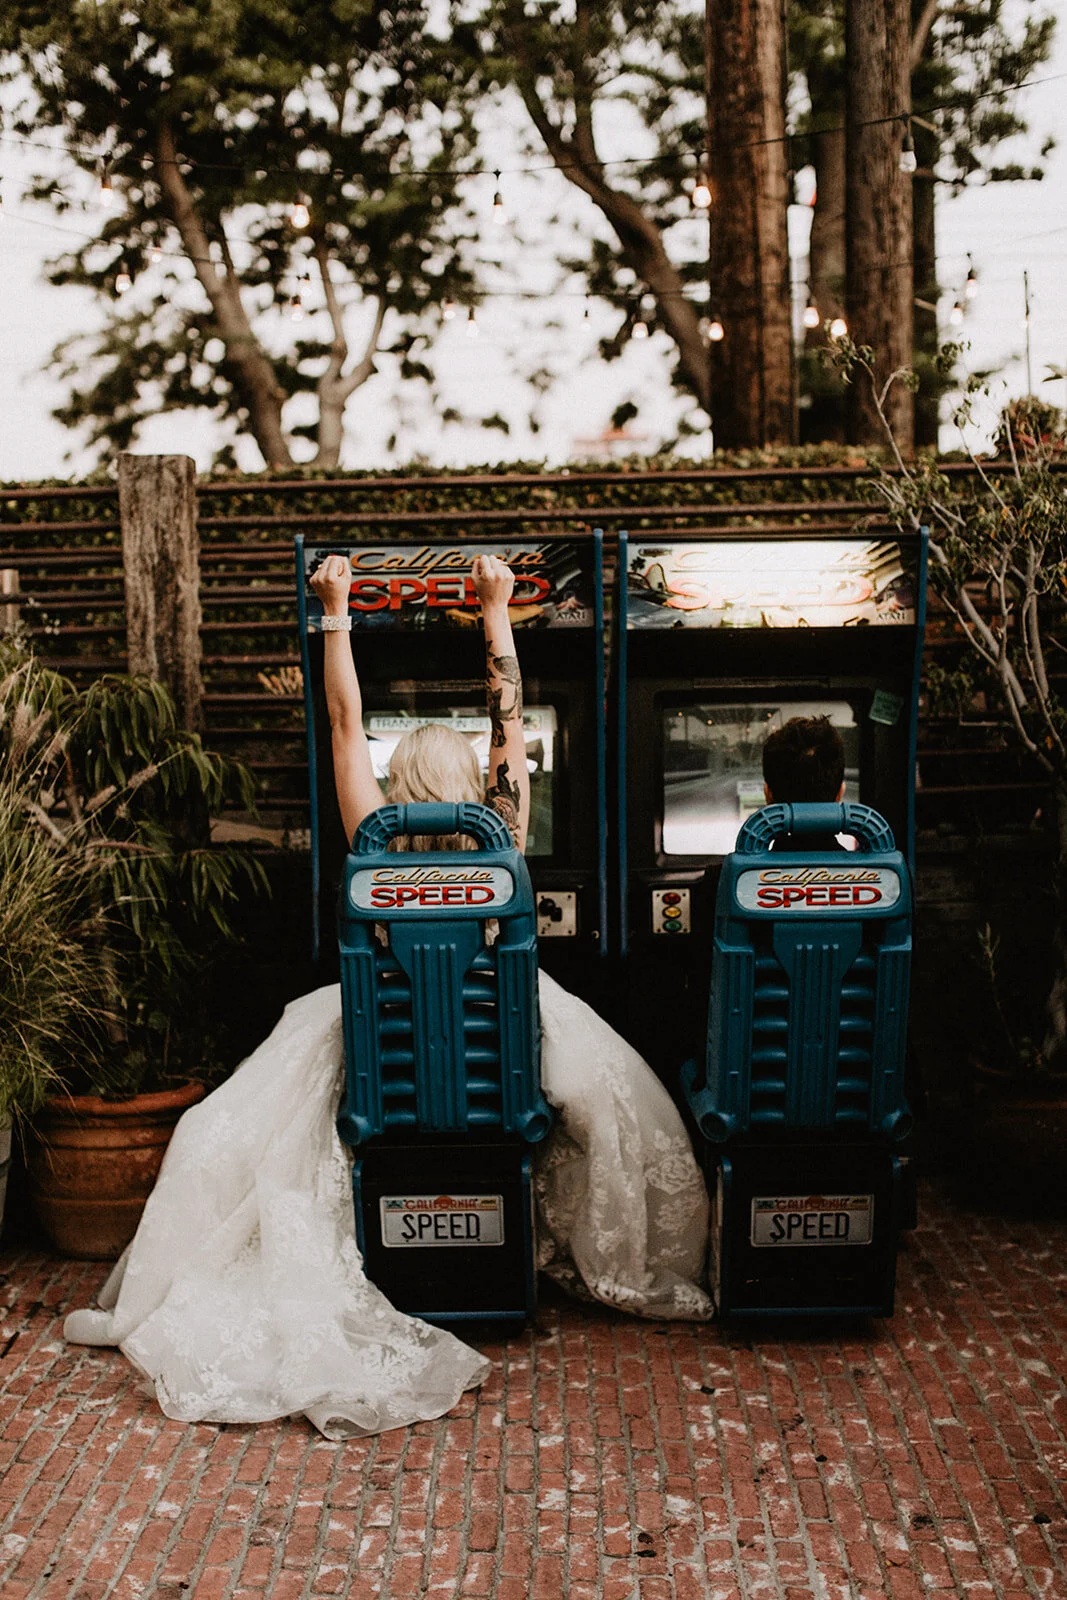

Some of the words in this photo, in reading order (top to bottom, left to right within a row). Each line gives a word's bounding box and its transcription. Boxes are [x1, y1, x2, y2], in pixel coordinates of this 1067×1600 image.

[351, 546, 547, 578] Califoia
[555, 609, 585, 620] ATARI
[372, 867, 494, 888] California
[759, 867, 882, 888] California
[370, 885, 495, 908] SPEED
[757, 885, 882, 908] SPEED
[404, 1198, 477, 1210] CALIFORNIA
[401, 1212, 481, 1240] SPEED
[769, 1212, 851, 1240] SPEED
